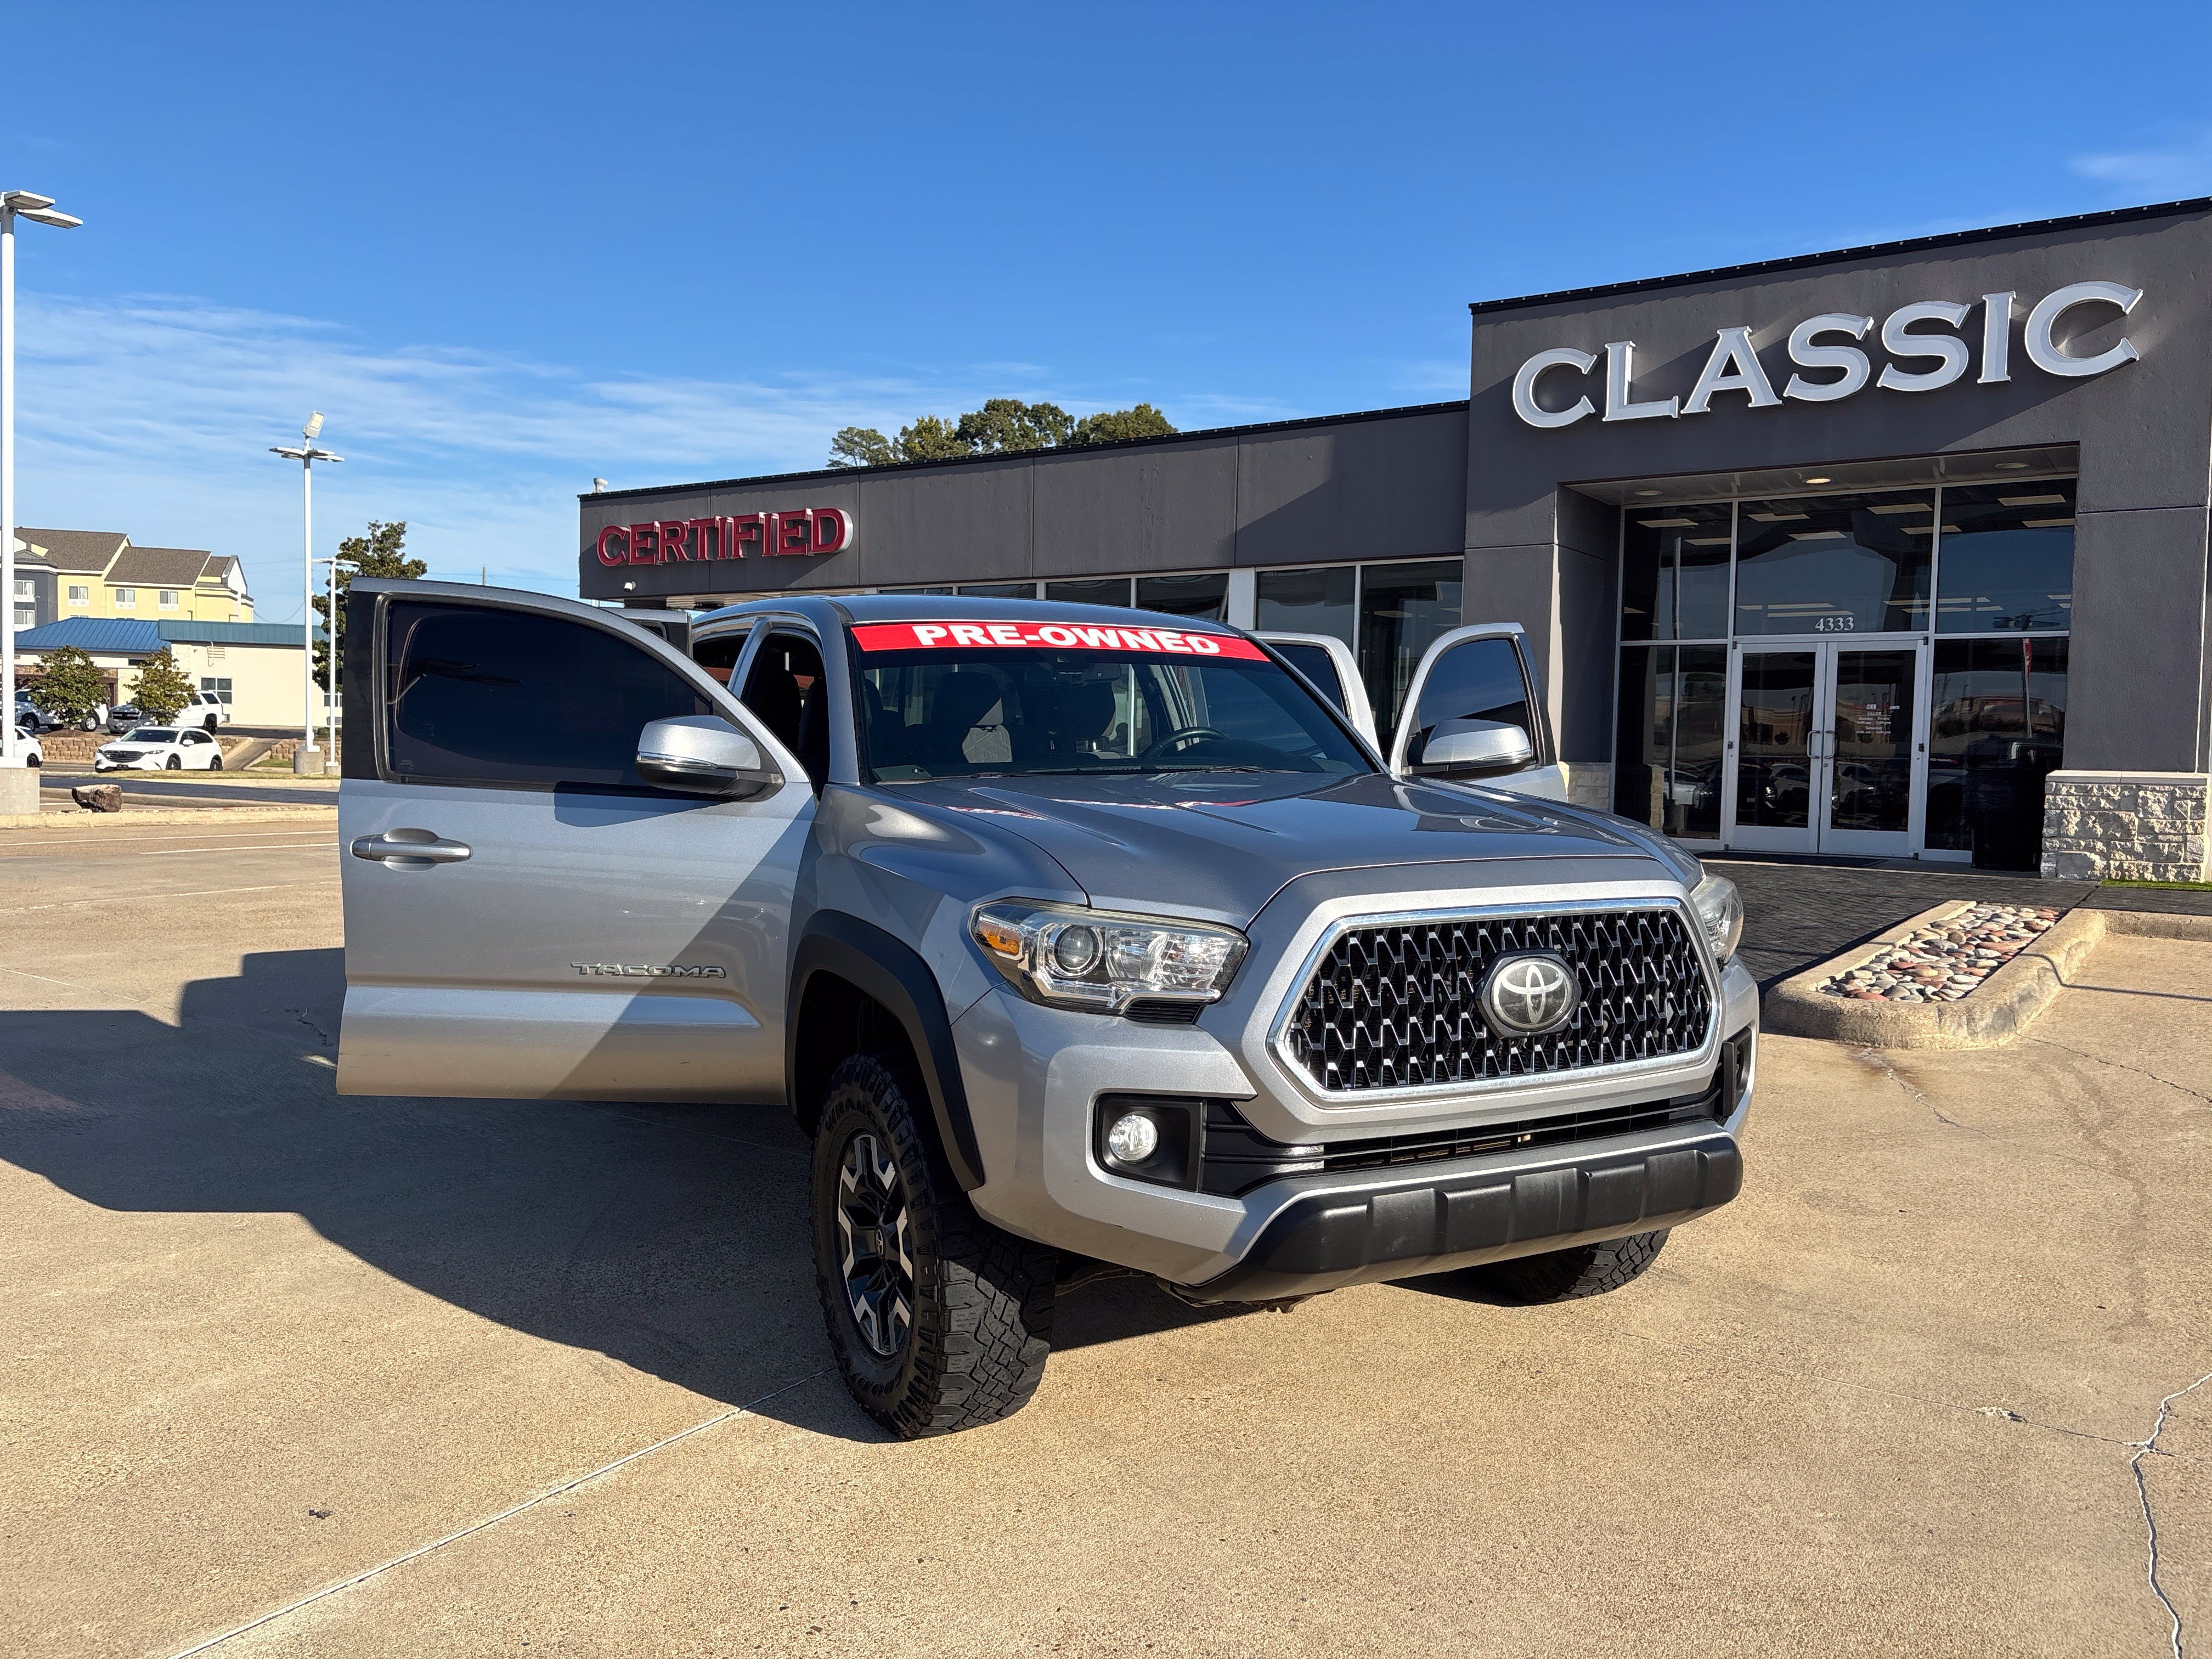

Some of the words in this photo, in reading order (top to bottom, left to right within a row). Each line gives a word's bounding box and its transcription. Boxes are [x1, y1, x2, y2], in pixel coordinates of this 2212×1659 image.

[1513, 281, 2143, 428] CLASSIC
[597, 507, 852, 567] CERTIFIED
[1815, 617, 1854, 631] 4333
[912, 625, 1221, 654] PRE-OWNED
[571, 962, 726, 978] TACOMA
